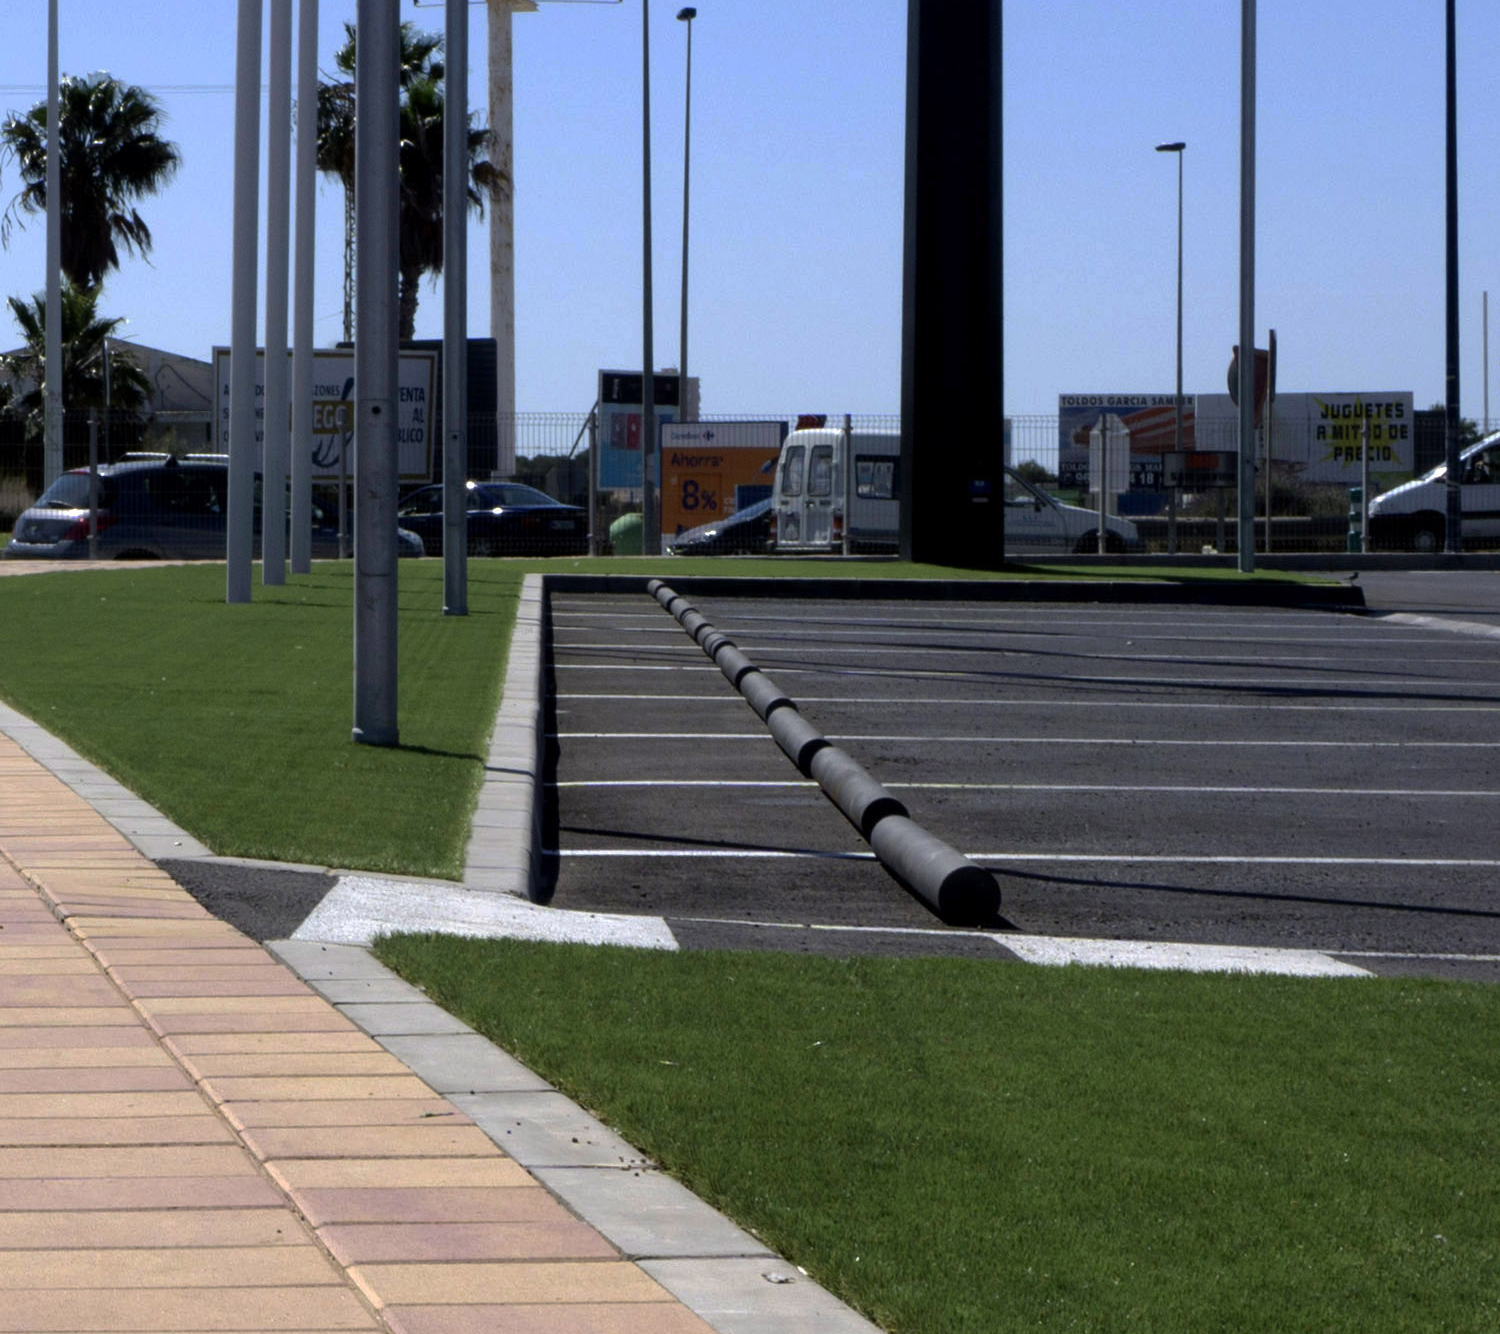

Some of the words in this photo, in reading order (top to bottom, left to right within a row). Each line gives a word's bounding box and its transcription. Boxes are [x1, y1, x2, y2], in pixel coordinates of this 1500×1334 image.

[1061, 396, 1103, 406] TOLDOS
[1321, 402, 1405, 419] JUGUETES
[1316, 424, 1326, 440] A
[1332, 424, 1382, 440] MITD
[1389, 424, 1409, 440] DE
[1333, 446, 1392, 462] PRECIO
